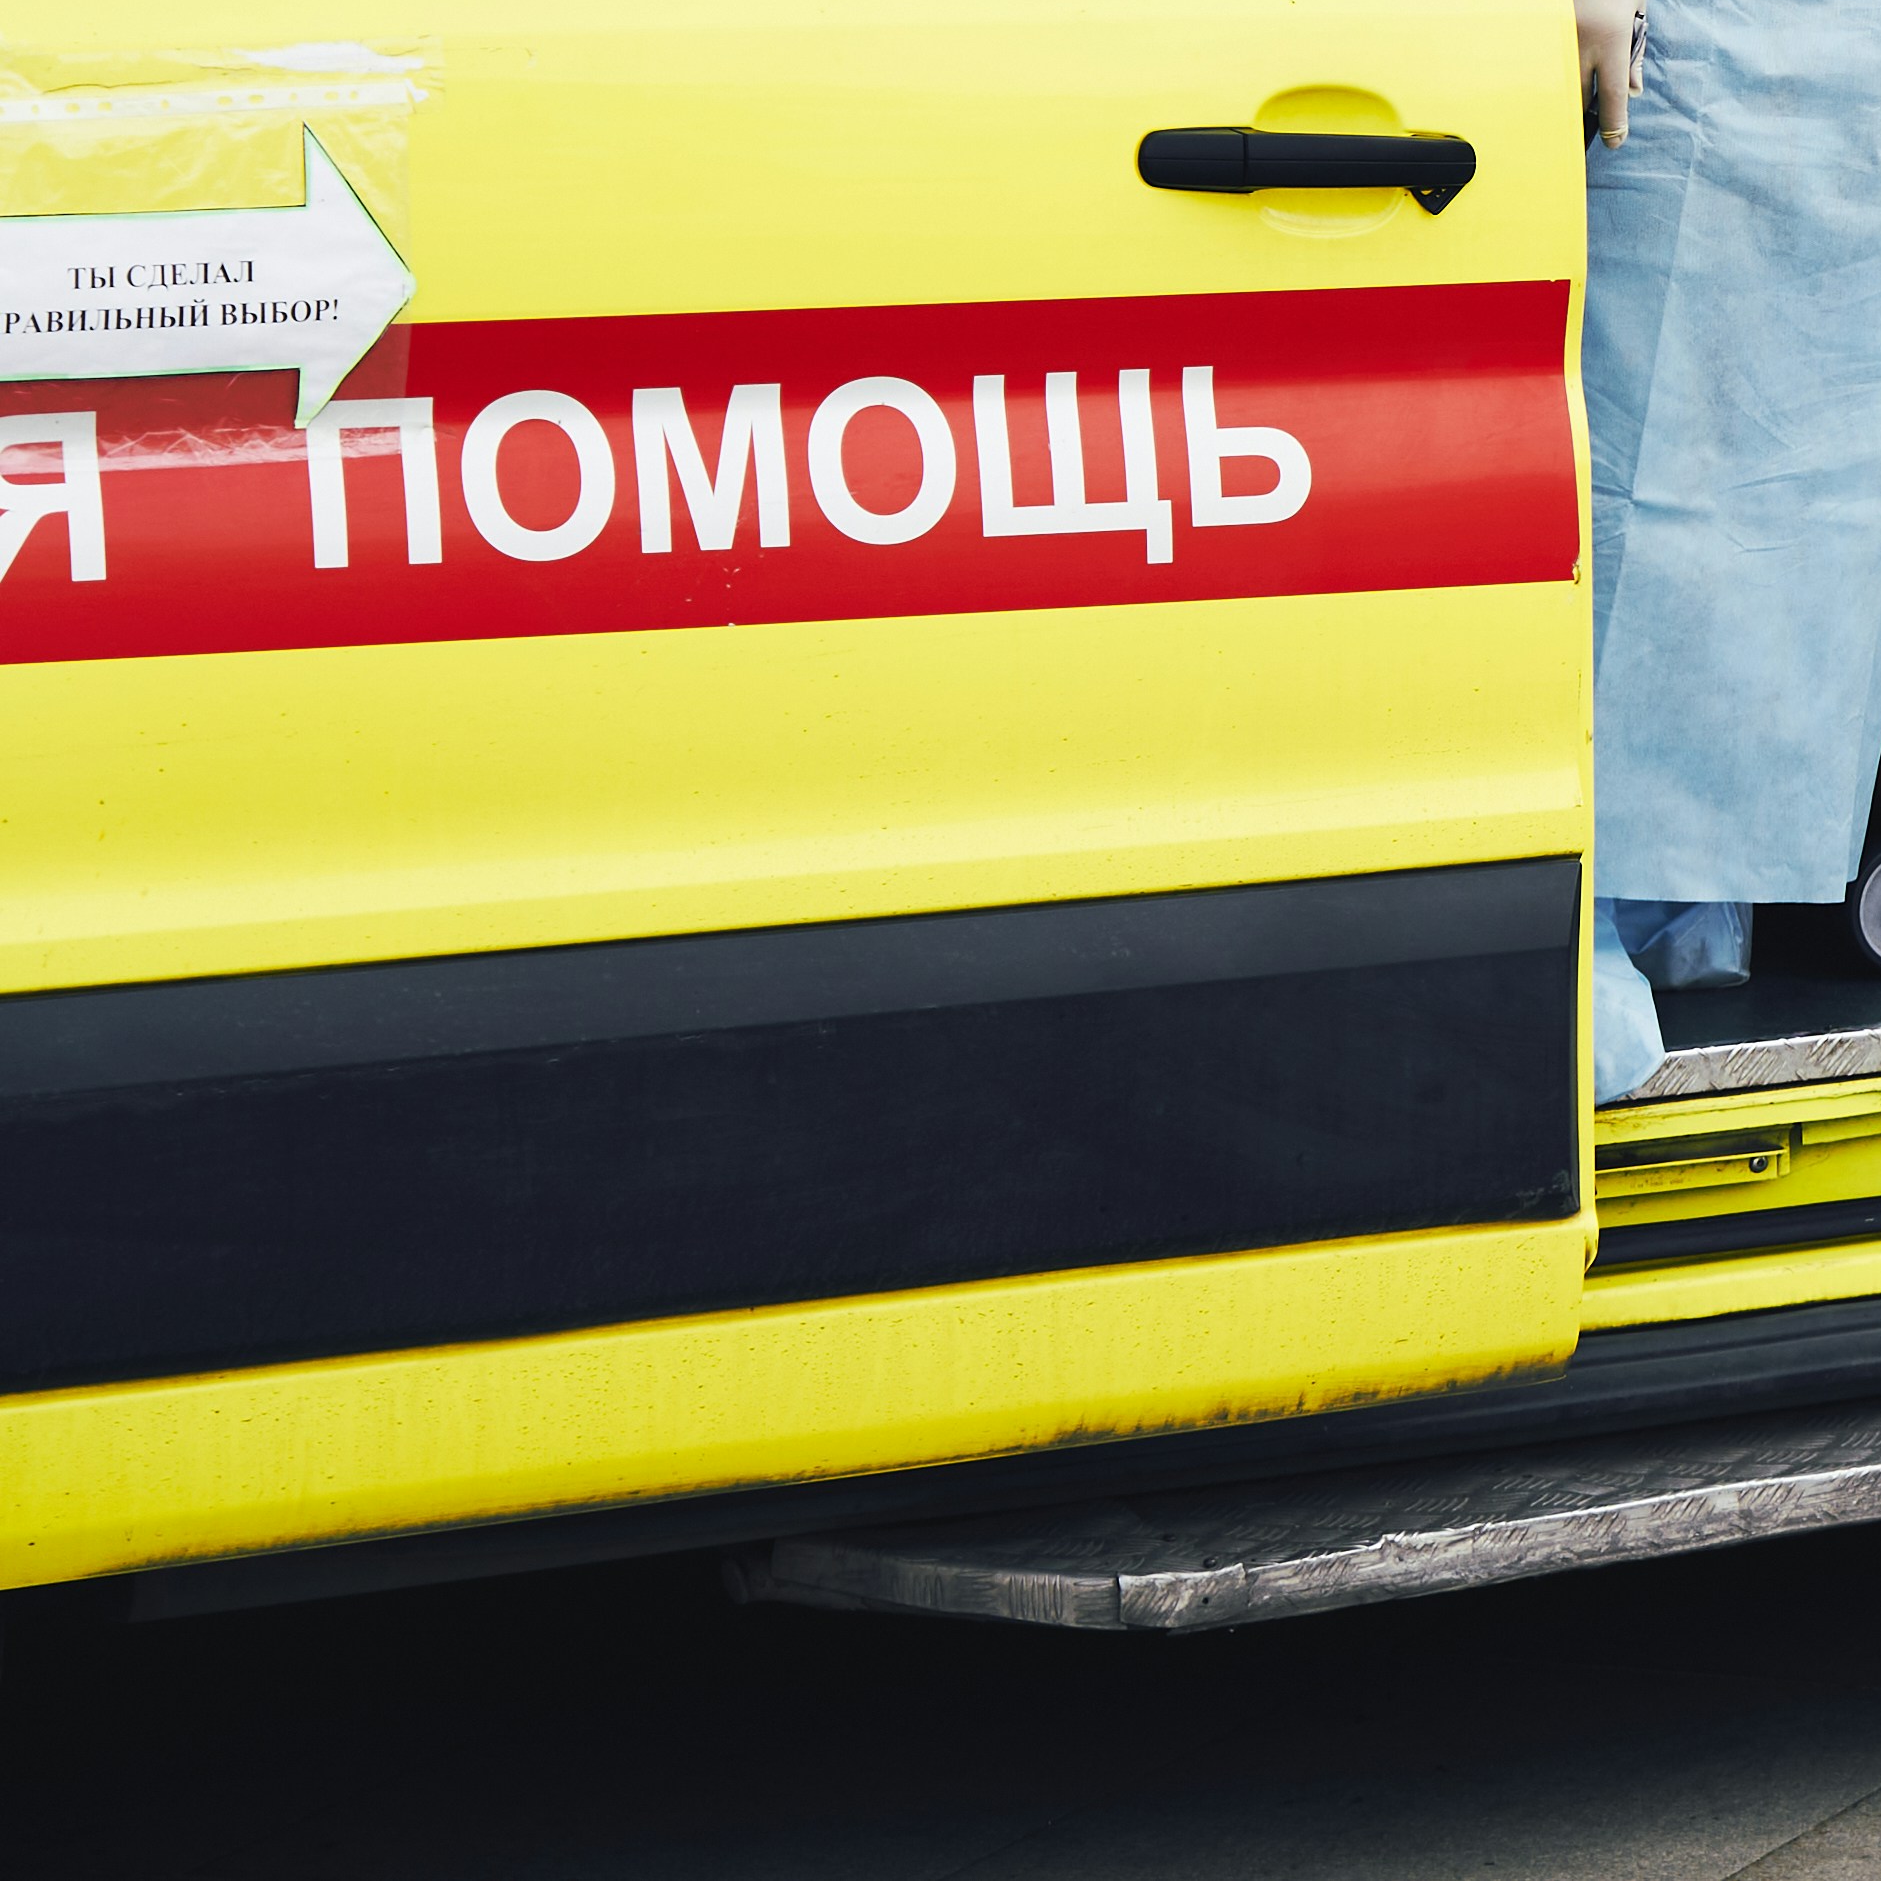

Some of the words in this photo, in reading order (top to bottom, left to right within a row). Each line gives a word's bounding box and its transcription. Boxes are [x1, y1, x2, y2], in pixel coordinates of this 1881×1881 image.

[67, 266, 116, 290] ТЫ
[126, 260, 255, 291] СДЕЛАЛ
[219, 298, 339, 326] ВЫБОР!
[307, 365, 1312, 570] ПОМОЩЬ
